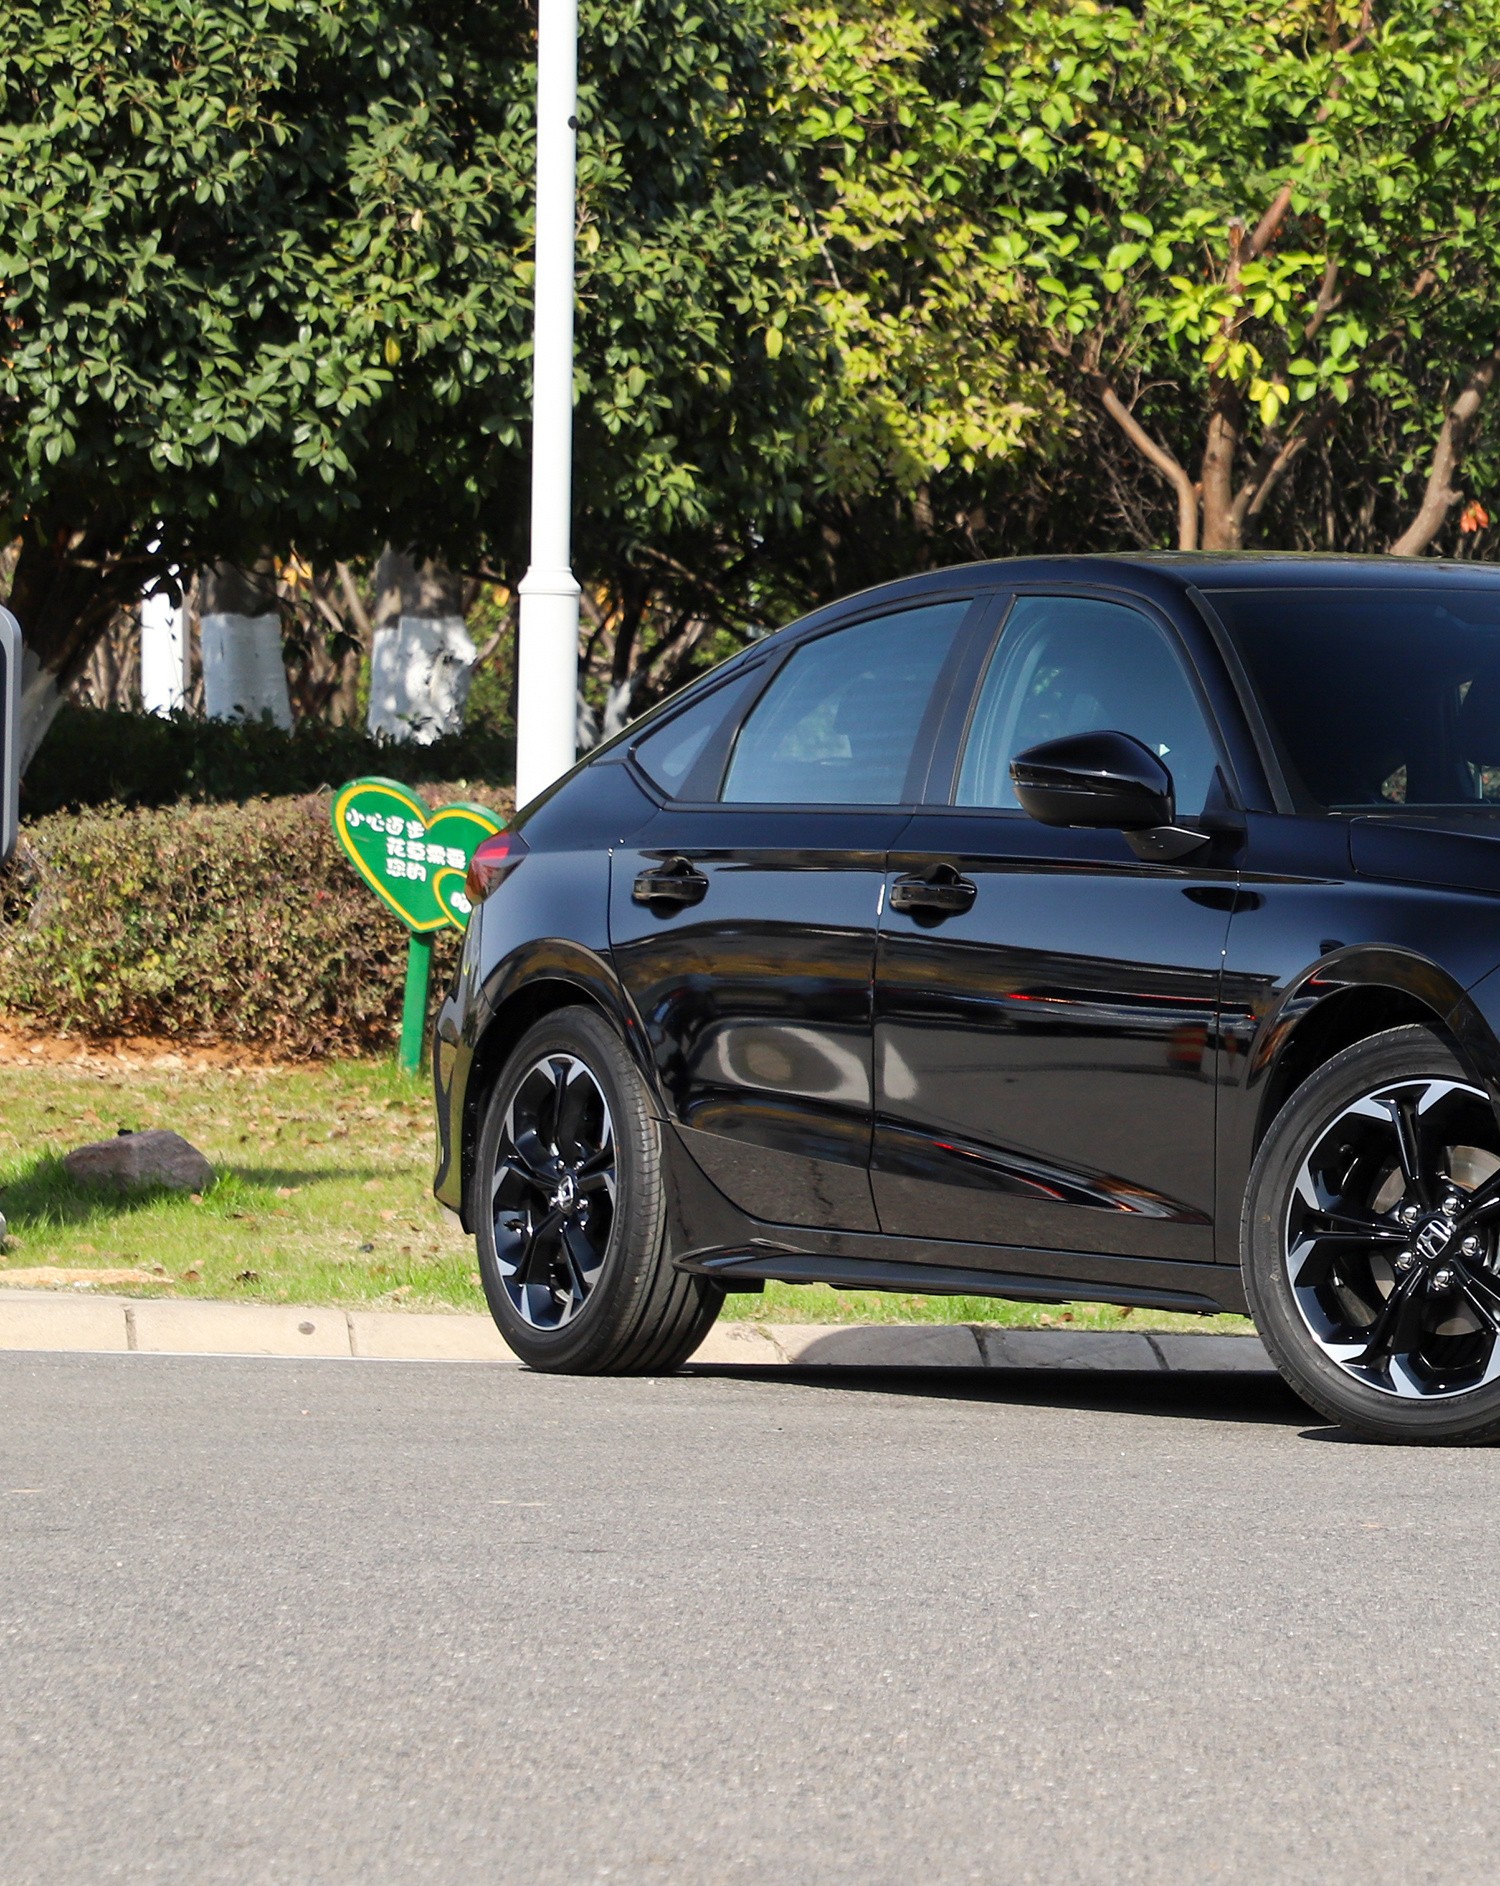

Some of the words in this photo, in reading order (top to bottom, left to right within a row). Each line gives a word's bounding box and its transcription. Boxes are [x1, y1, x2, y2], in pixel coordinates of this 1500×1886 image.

[346, 808, 424, 839] 小心迈步
[385, 836, 466, 869] 花草需要
[385, 857, 427, 882] 您的
